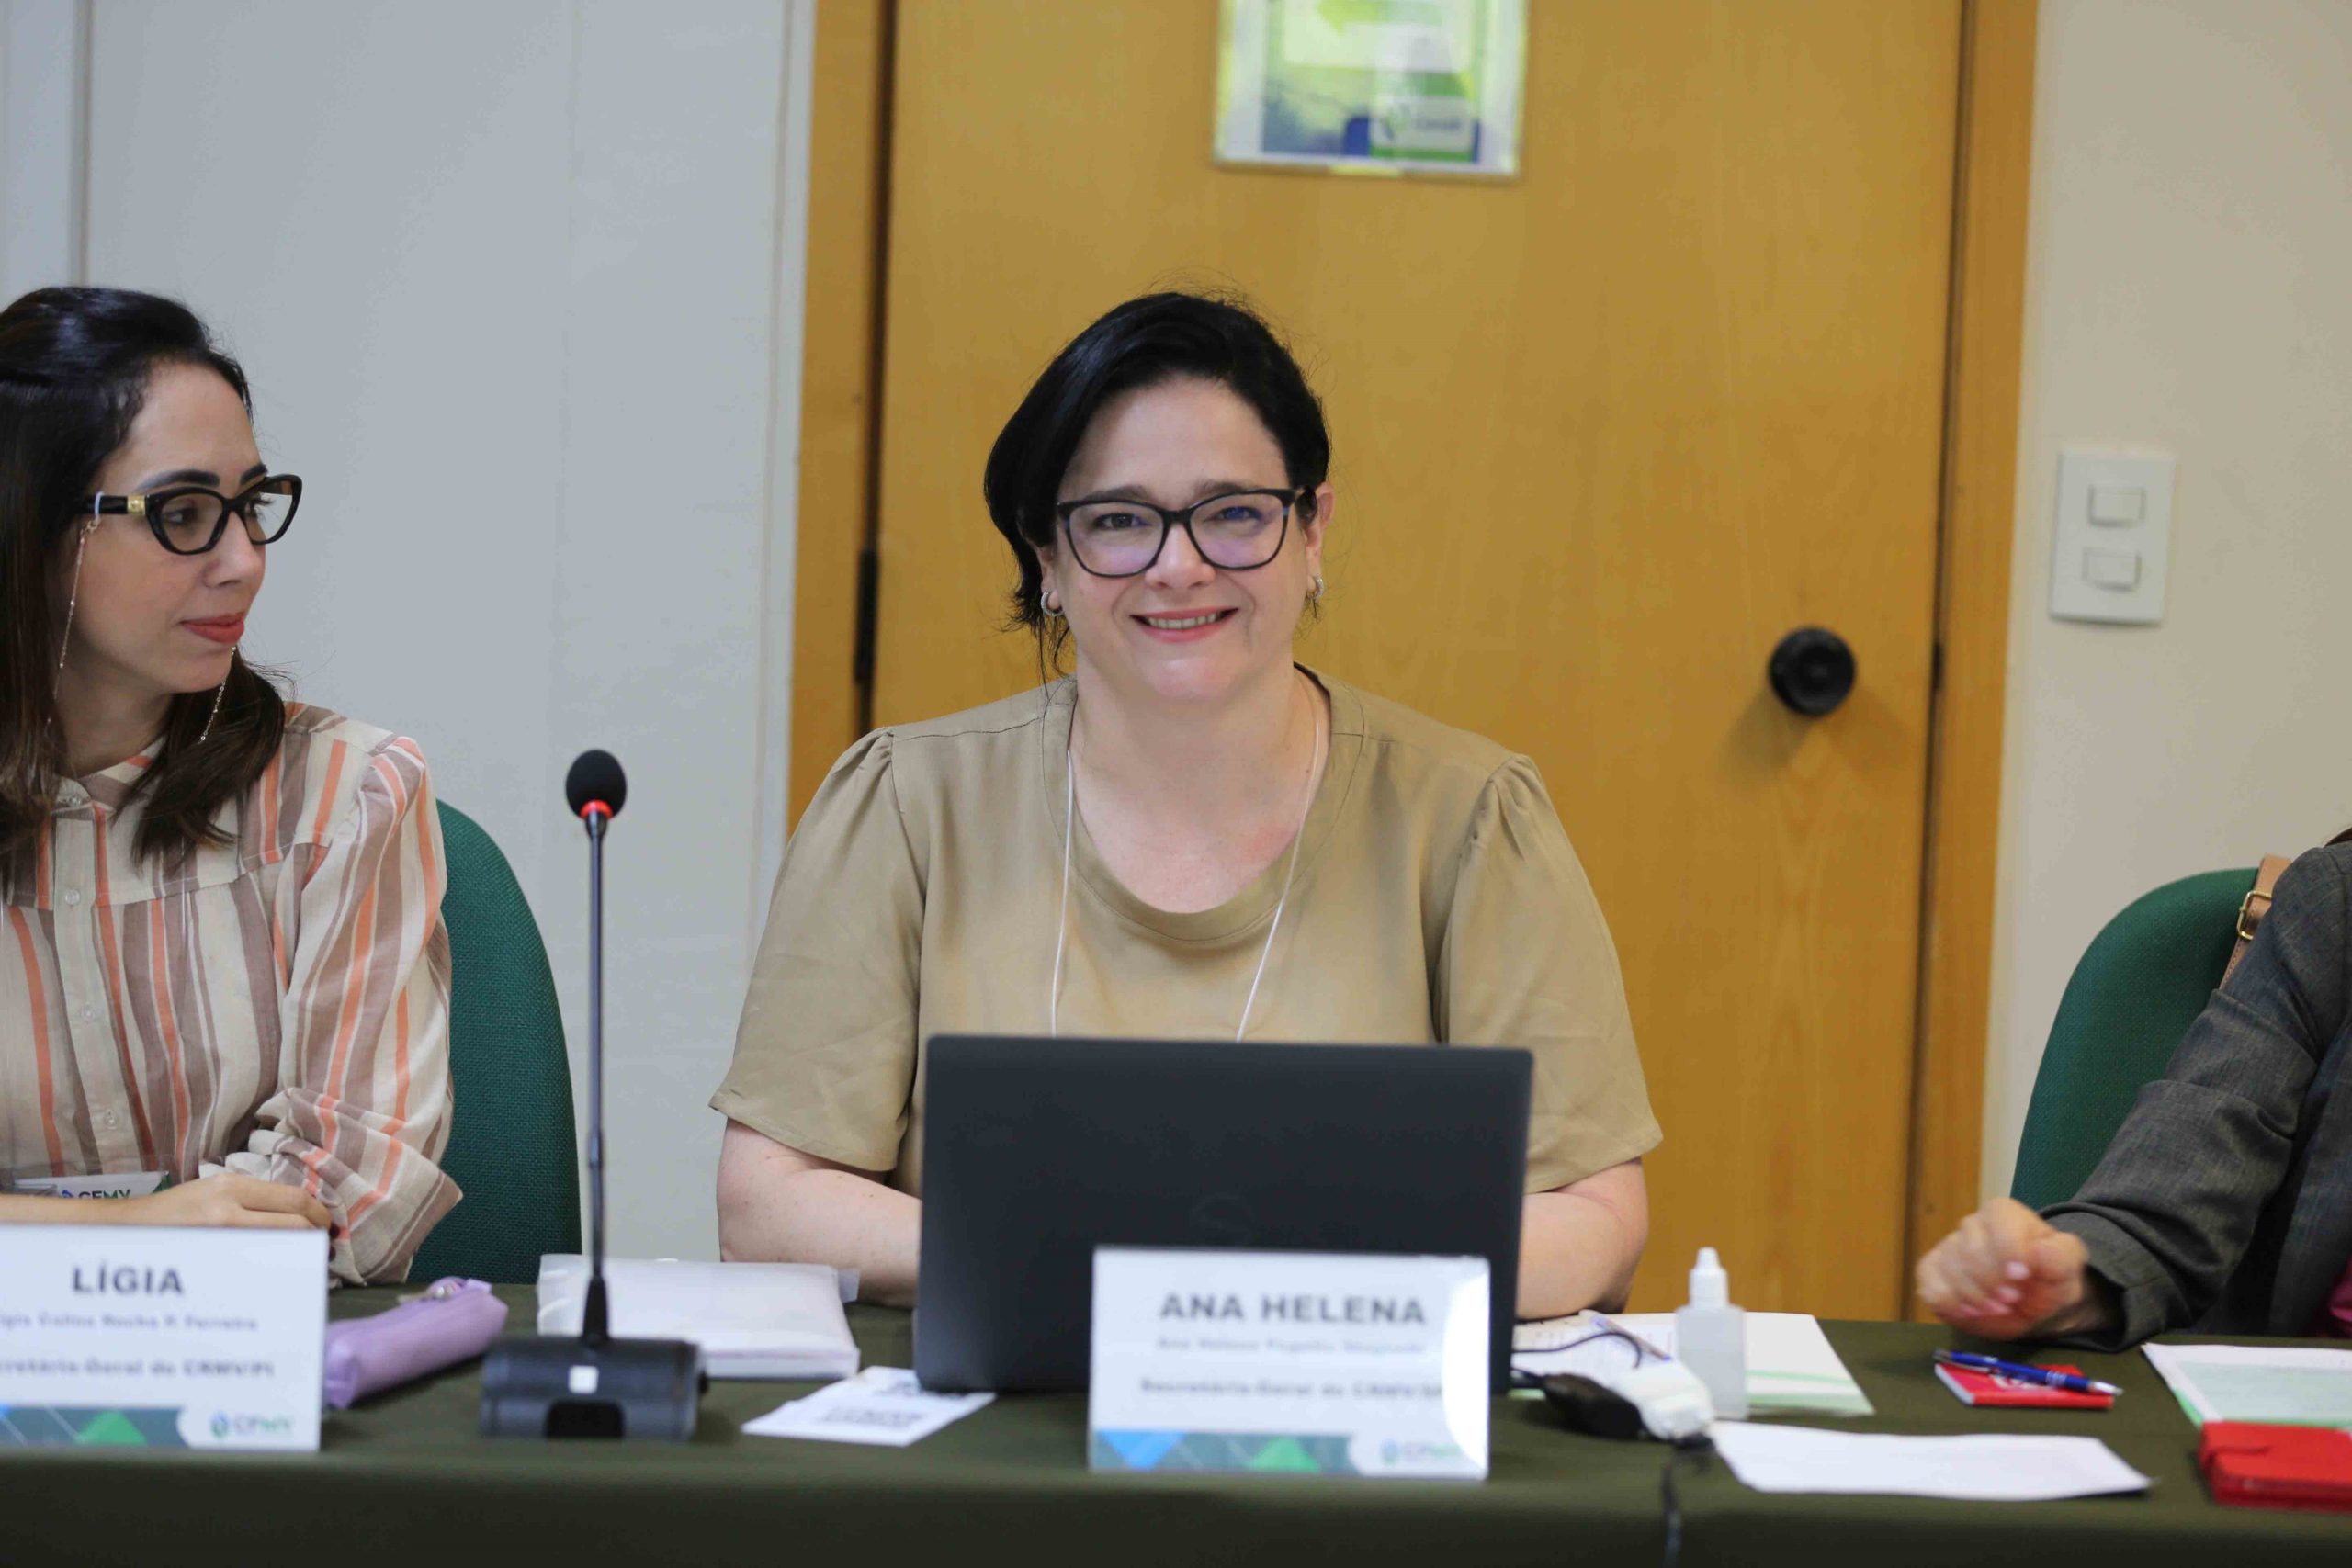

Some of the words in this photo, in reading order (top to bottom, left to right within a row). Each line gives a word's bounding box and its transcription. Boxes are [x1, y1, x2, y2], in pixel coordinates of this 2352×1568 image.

[72, 1259, 185, 1293] LÍGIA
[1159, 1292, 1244, 1320] ANA
[1261, 1295, 1426, 1325] HELENA
